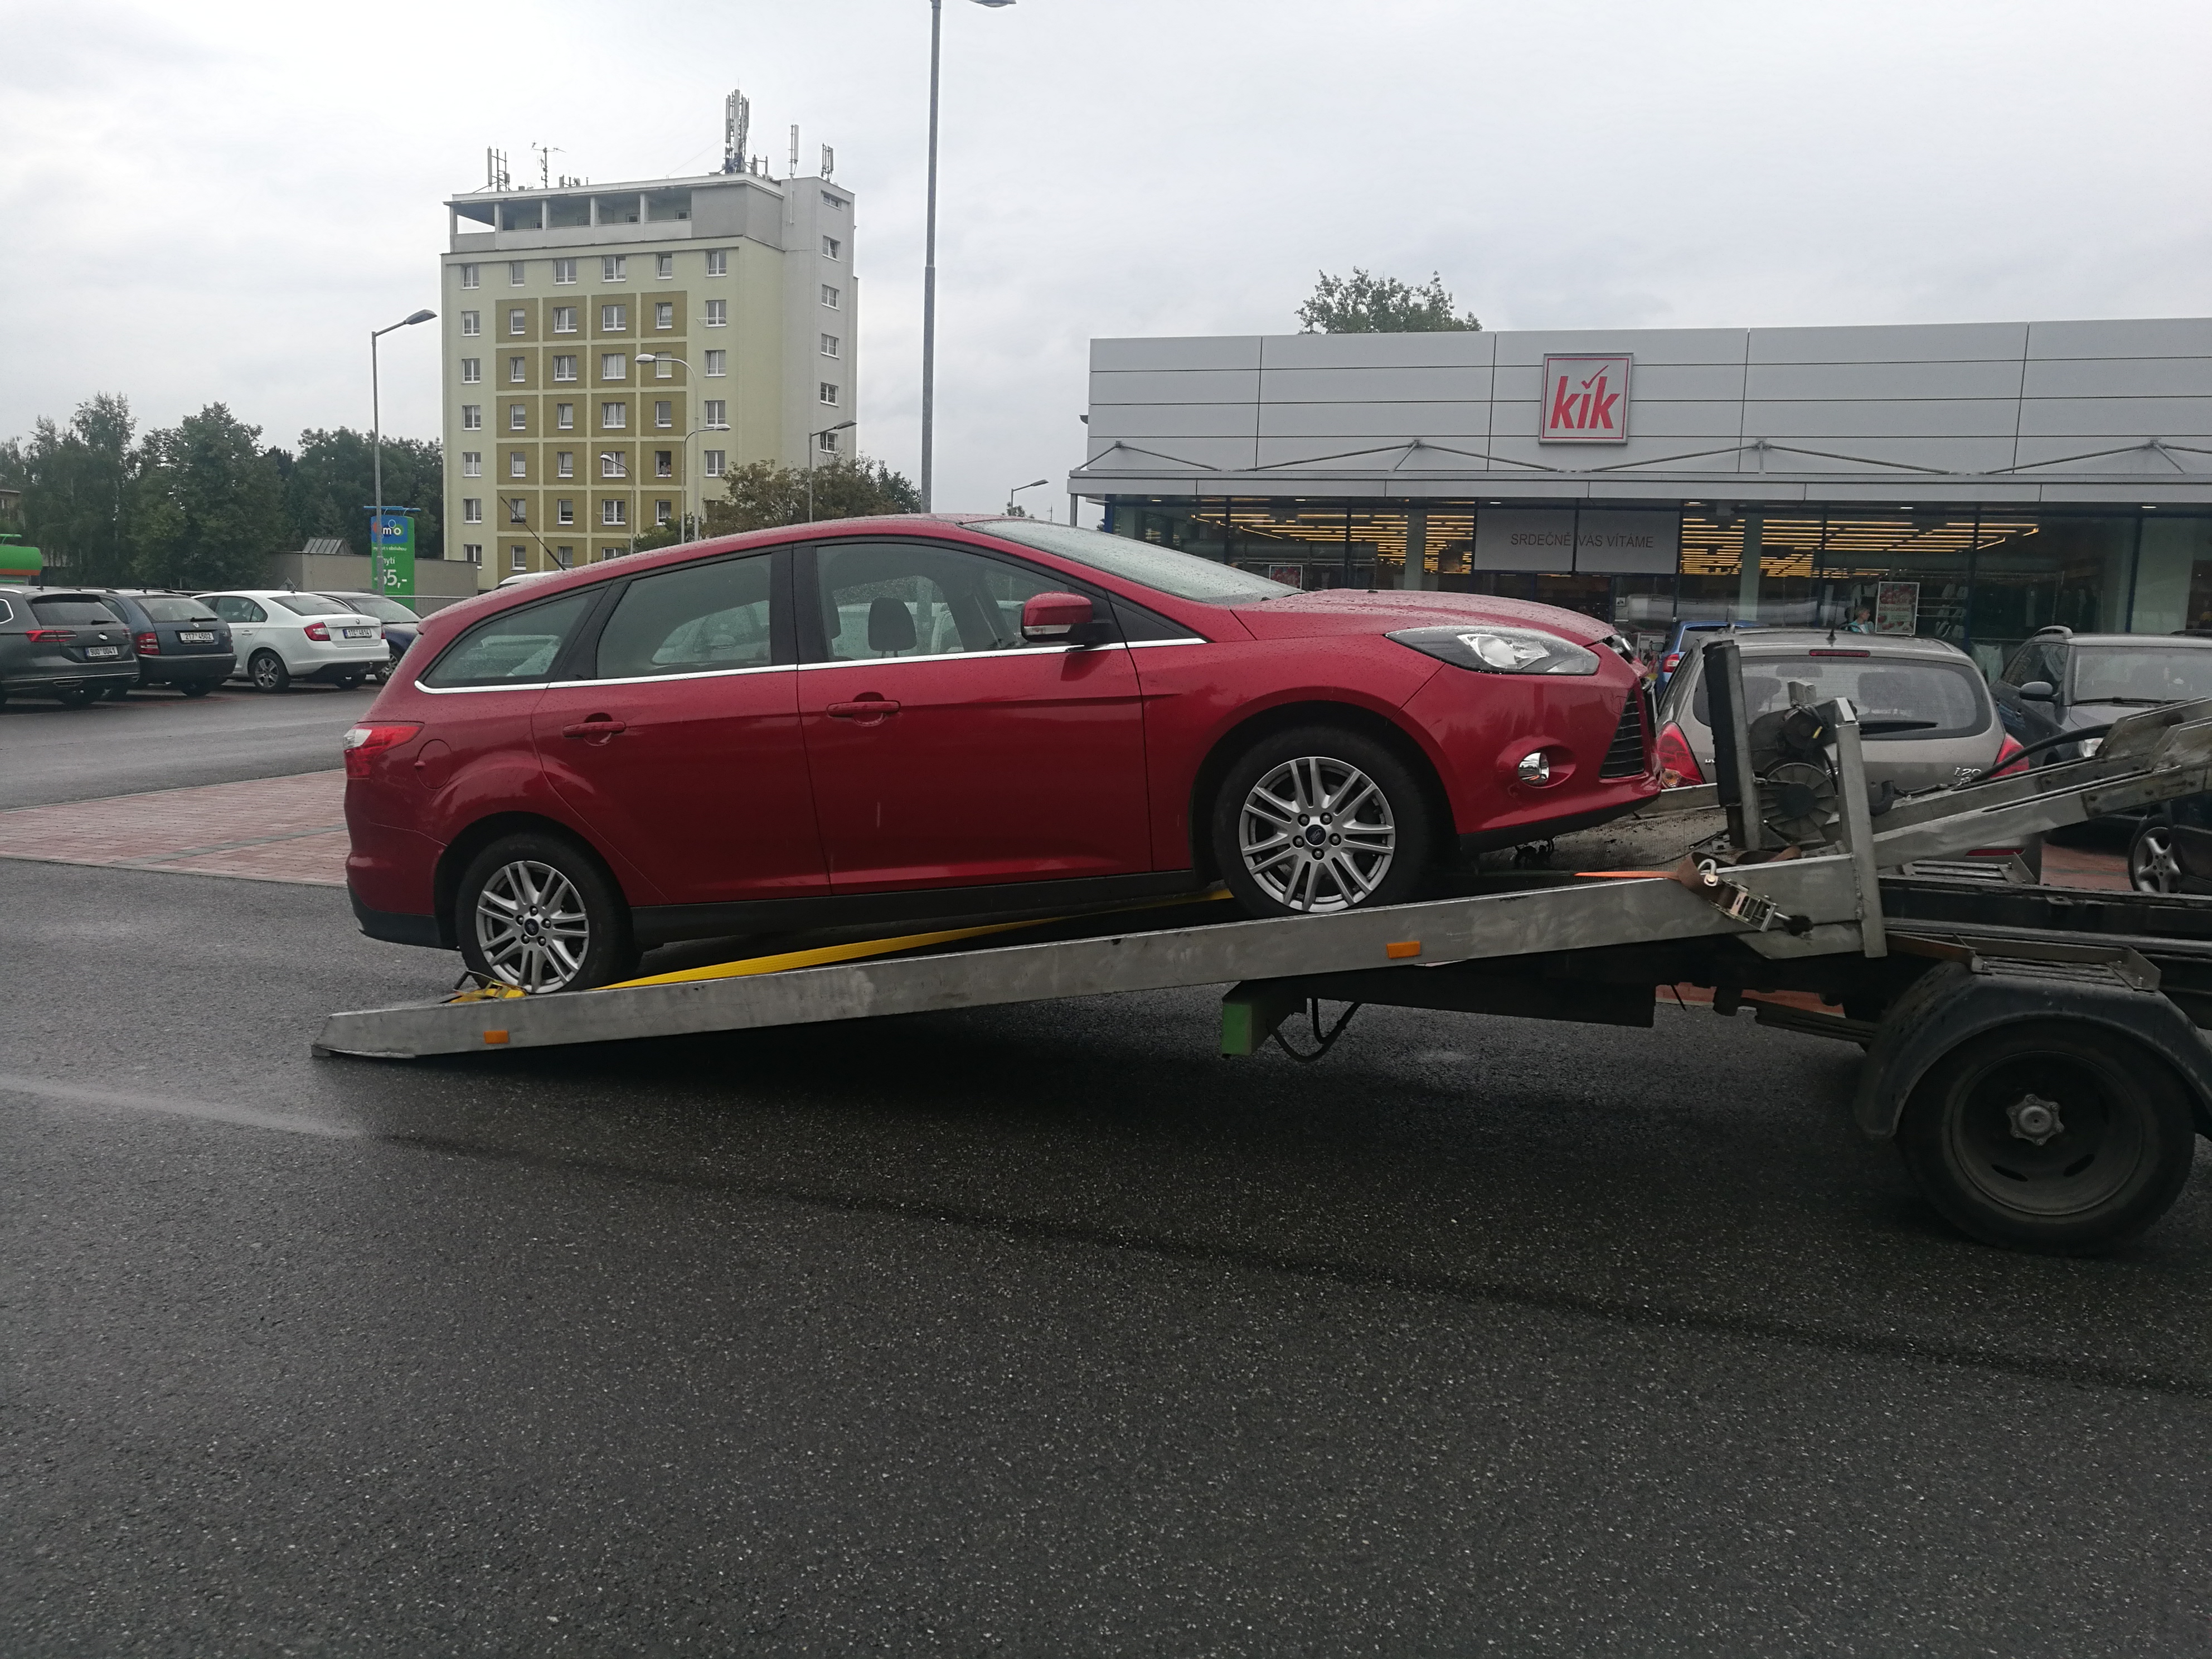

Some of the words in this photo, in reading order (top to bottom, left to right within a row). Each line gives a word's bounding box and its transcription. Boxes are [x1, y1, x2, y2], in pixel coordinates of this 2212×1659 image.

[1511, 531, 1571, 546] SRDEČNĚ
[1578, 533, 1603, 547] VÁS
[1607, 533, 1654, 548] VÍTÁME
